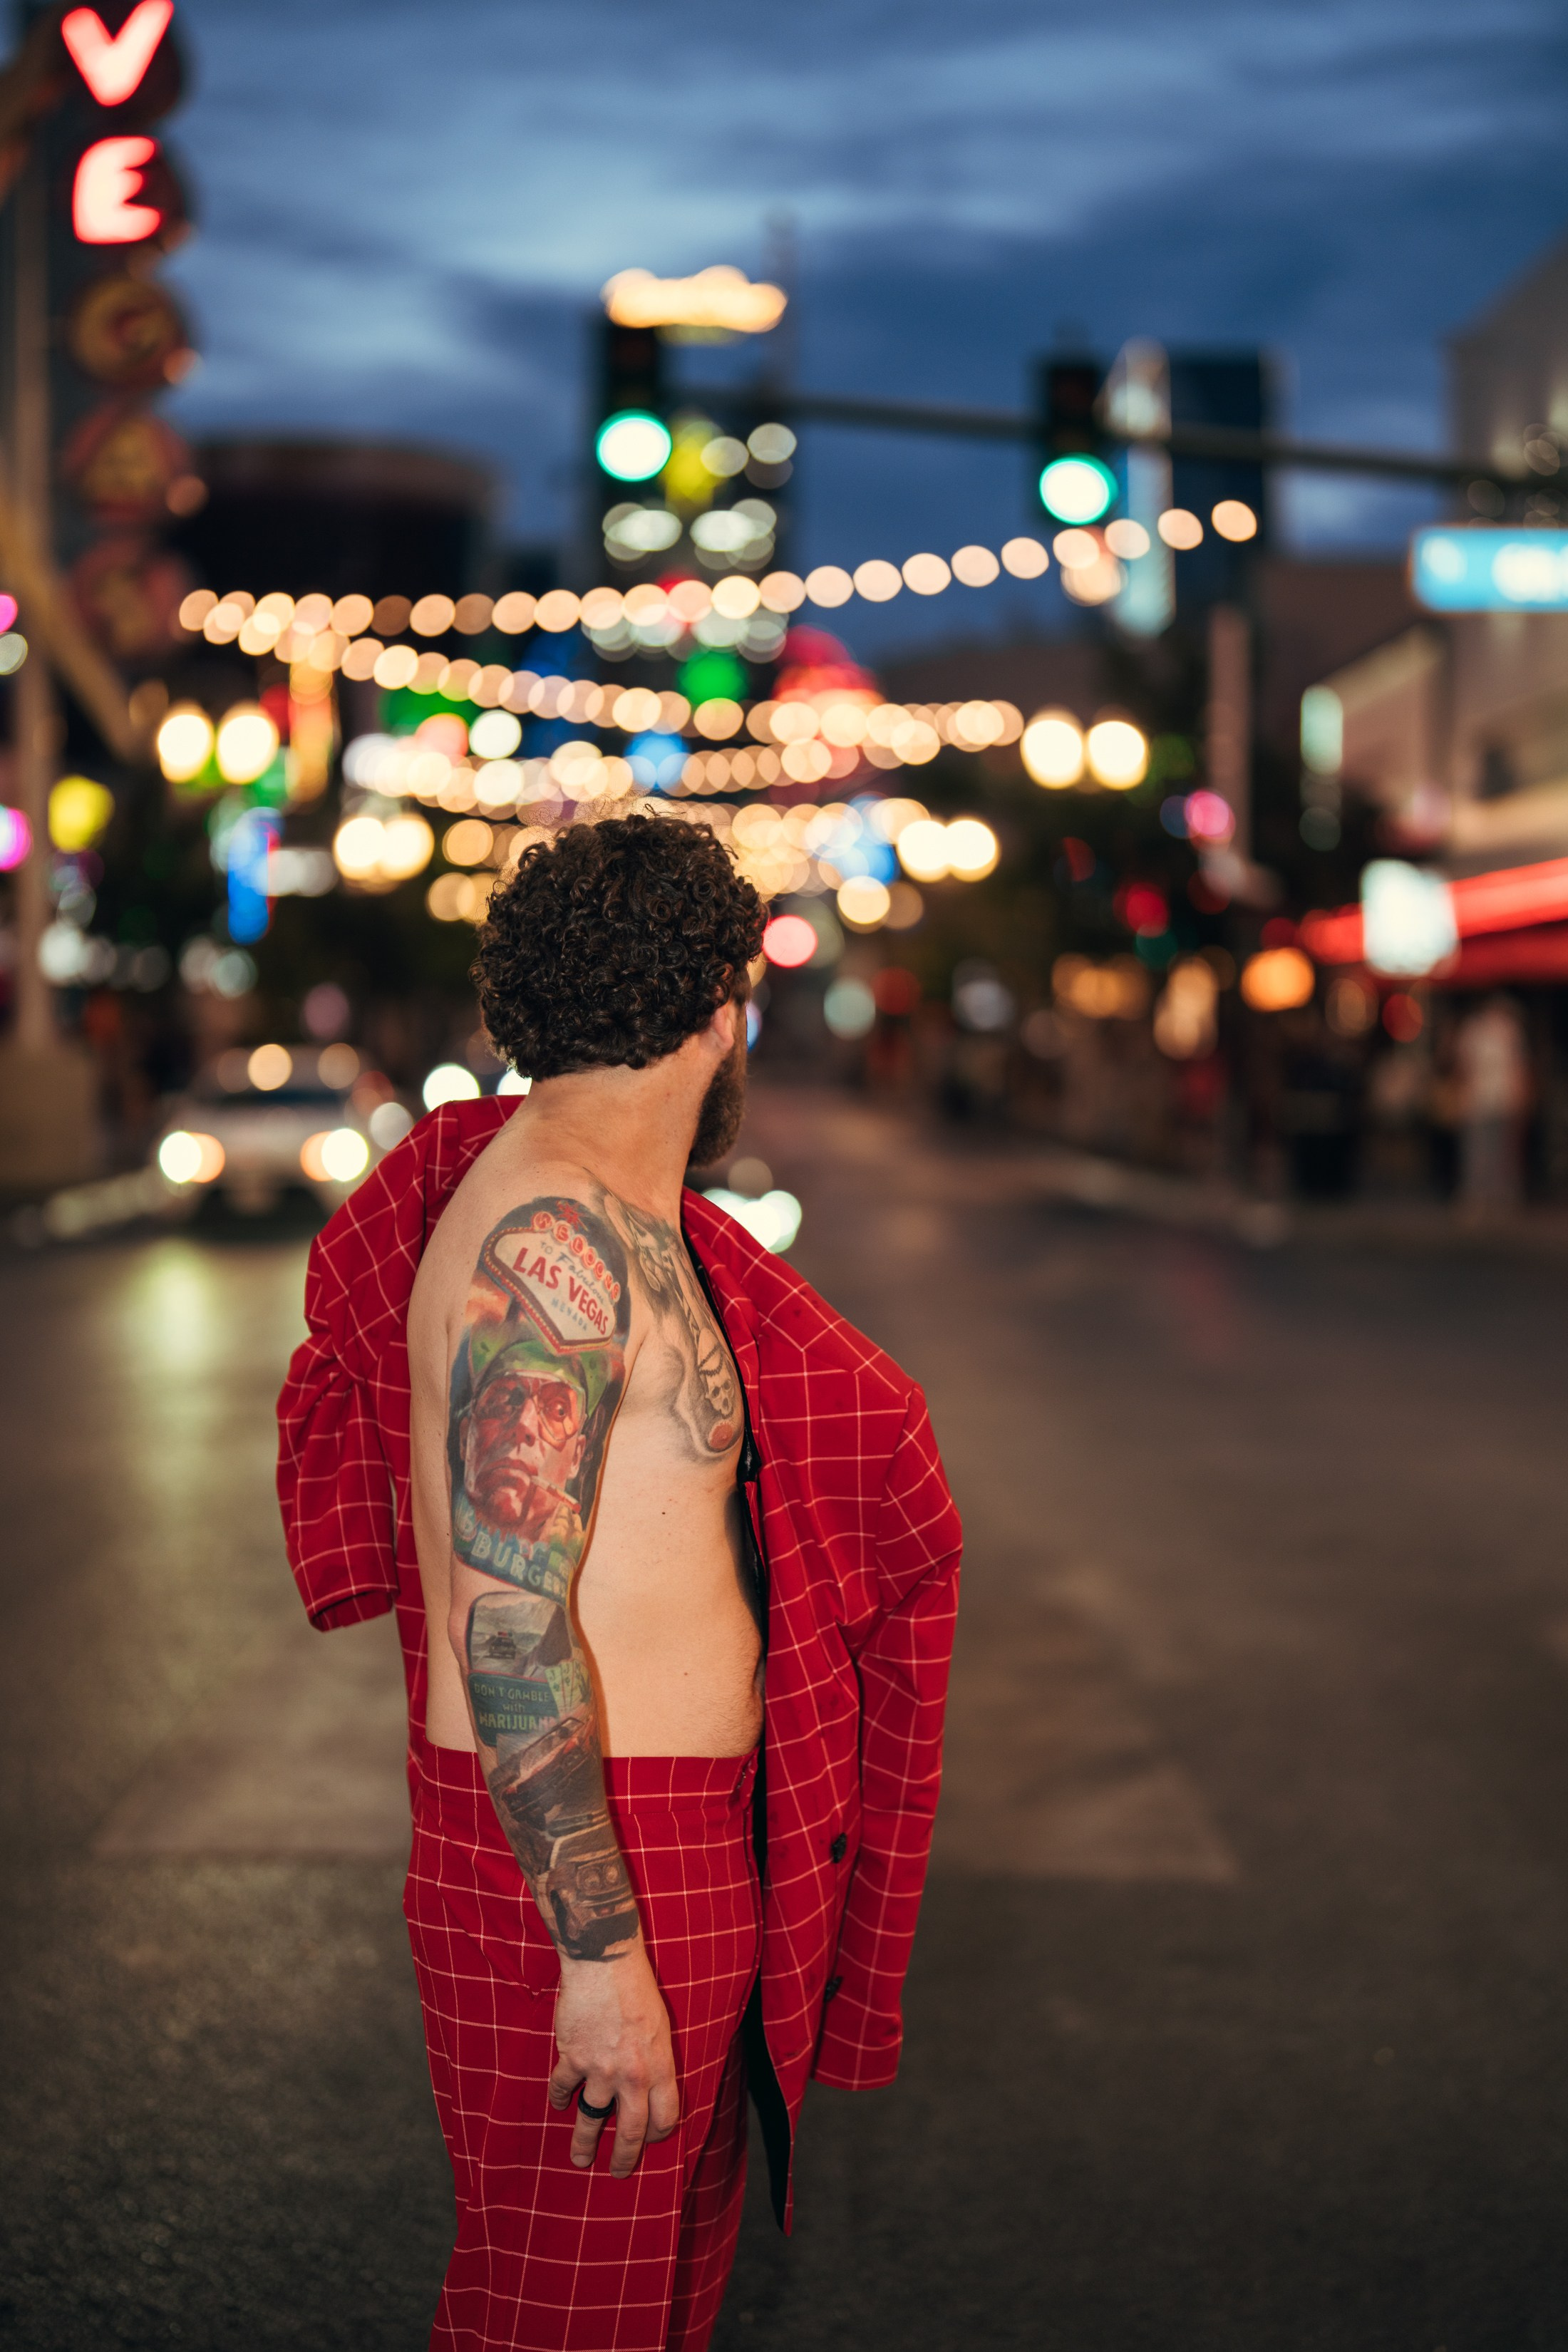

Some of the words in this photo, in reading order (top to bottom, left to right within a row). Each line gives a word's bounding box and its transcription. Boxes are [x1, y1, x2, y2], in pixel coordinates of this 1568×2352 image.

[512, 1247, 562, 1289] LAS
[569, 1275, 609, 1336] VEGAS
[550, 1297, 588, 1331] NEVADA
[474, 1683, 505, 1695] DON'T
[507, 1687, 550, 1702] GAMBLE
[502, 1702, 525, 1713] with
